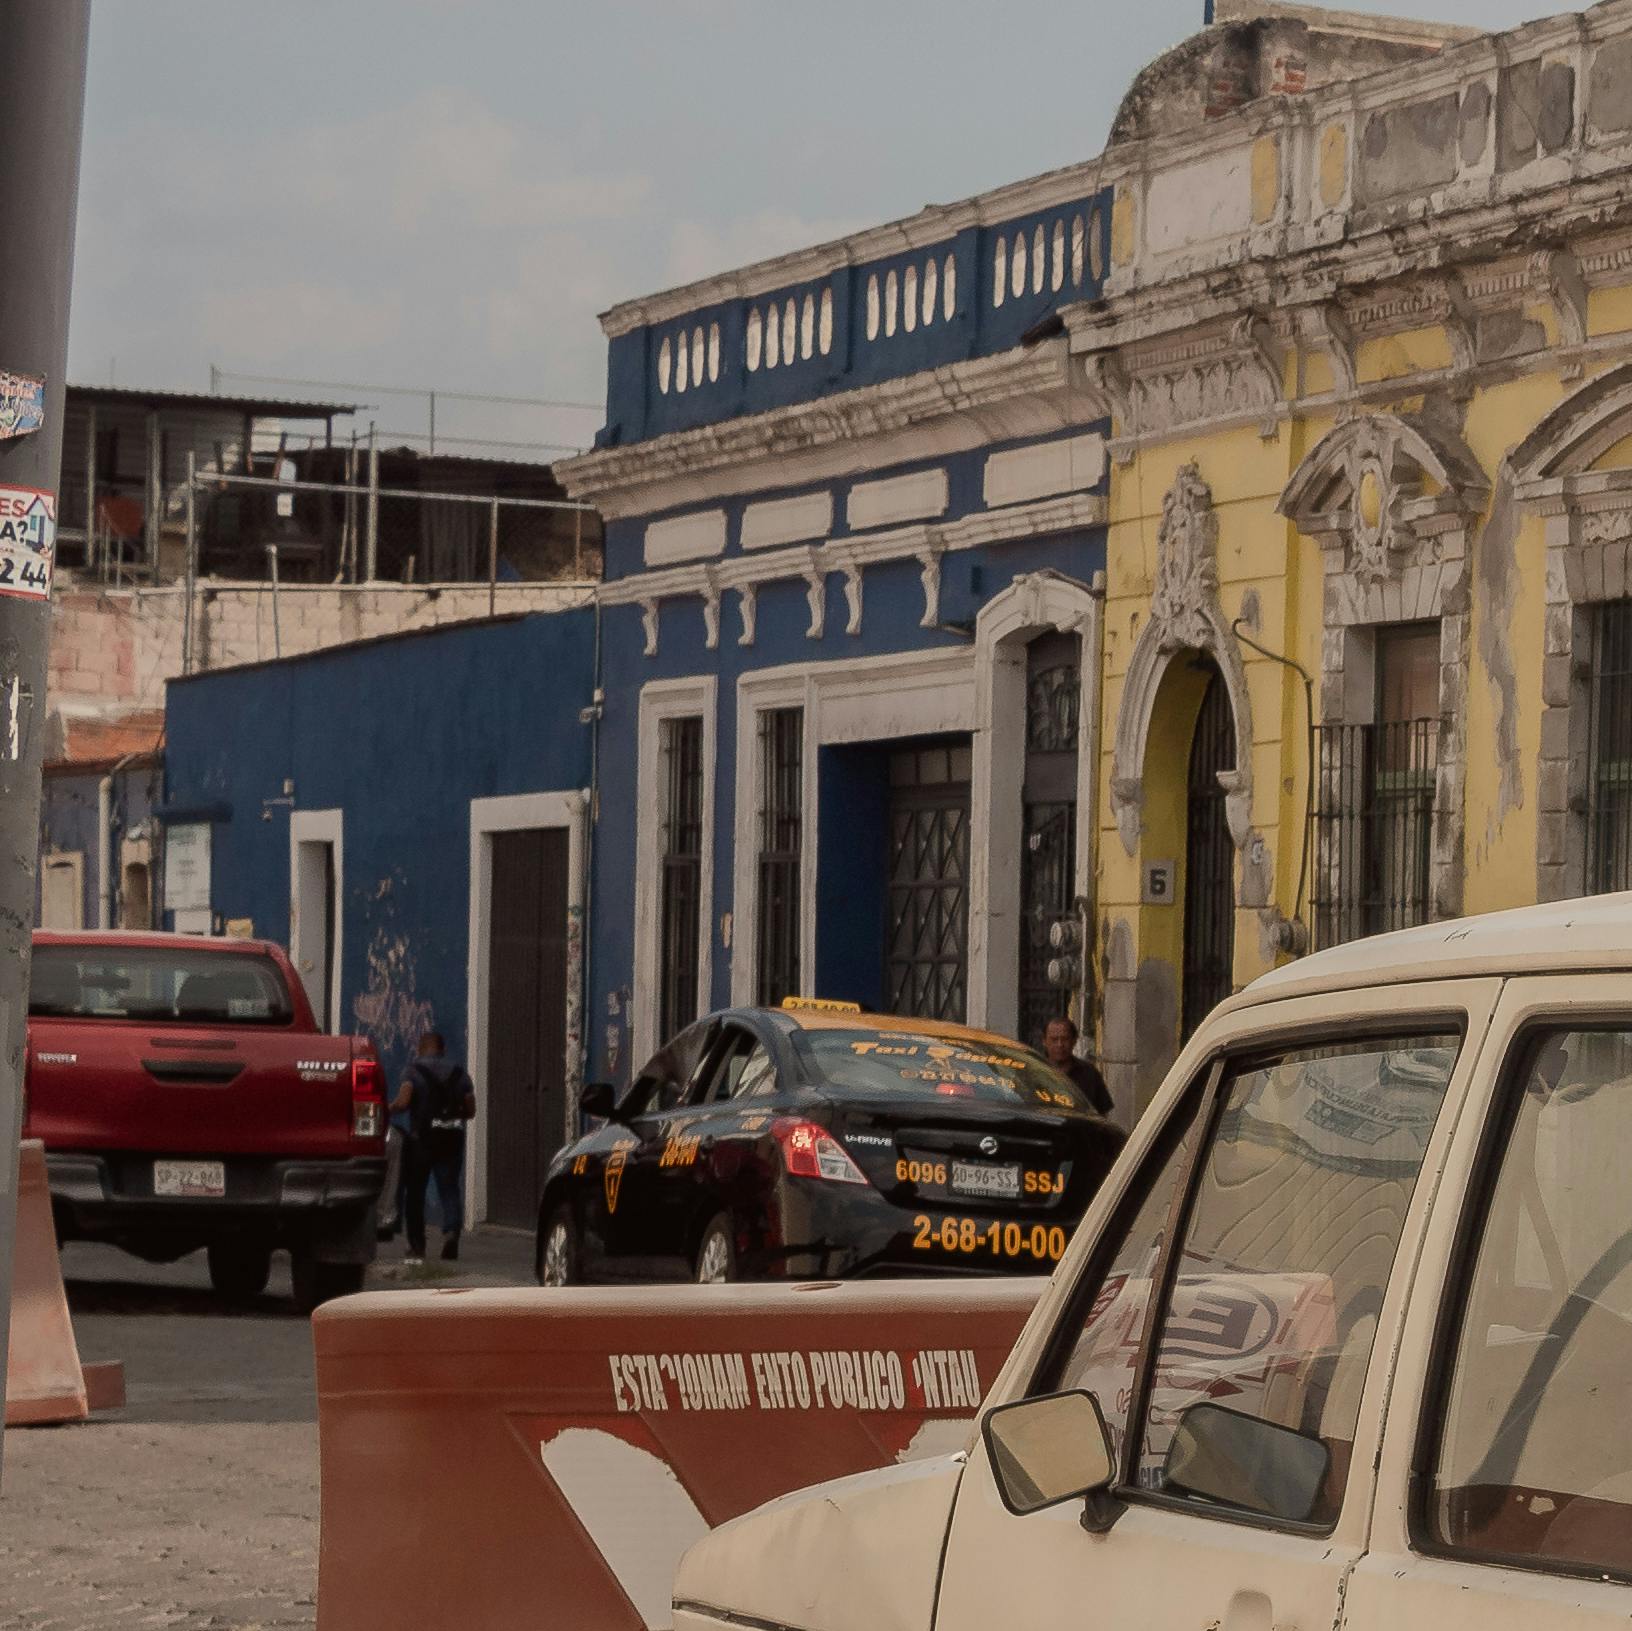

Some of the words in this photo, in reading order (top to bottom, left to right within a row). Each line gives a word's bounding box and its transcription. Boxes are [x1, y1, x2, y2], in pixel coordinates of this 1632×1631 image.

[895, 1159, 947, 1185] 6096
[1023, 1170, 1065, 1194] SSJ
[912, 1214, 1066, 1261] 2-68-10-00
[809, 1350, 905, 1410] PUBLICO
